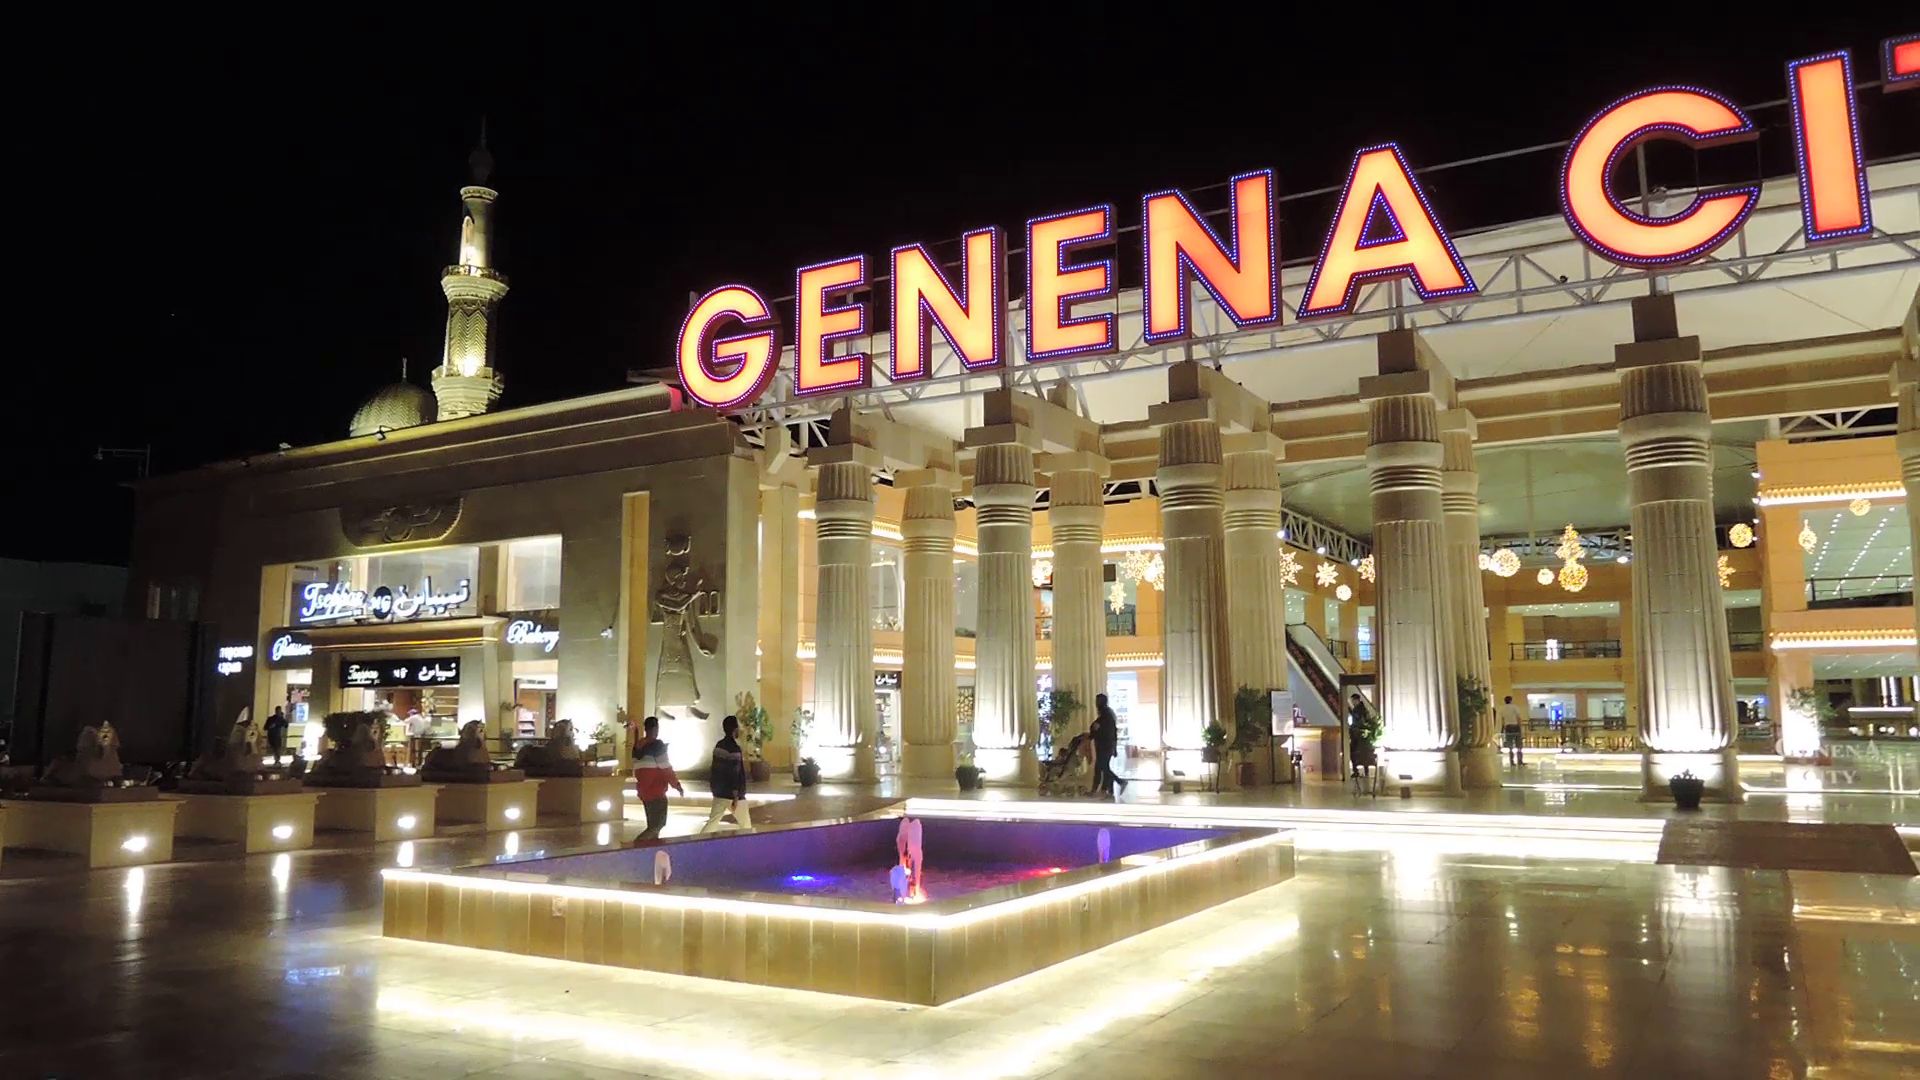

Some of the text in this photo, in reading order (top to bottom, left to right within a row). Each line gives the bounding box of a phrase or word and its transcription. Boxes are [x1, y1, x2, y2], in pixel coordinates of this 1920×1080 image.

[676, 33, 1920, 408] GENENA CI
[507, 620, 559, 653] Bakery
